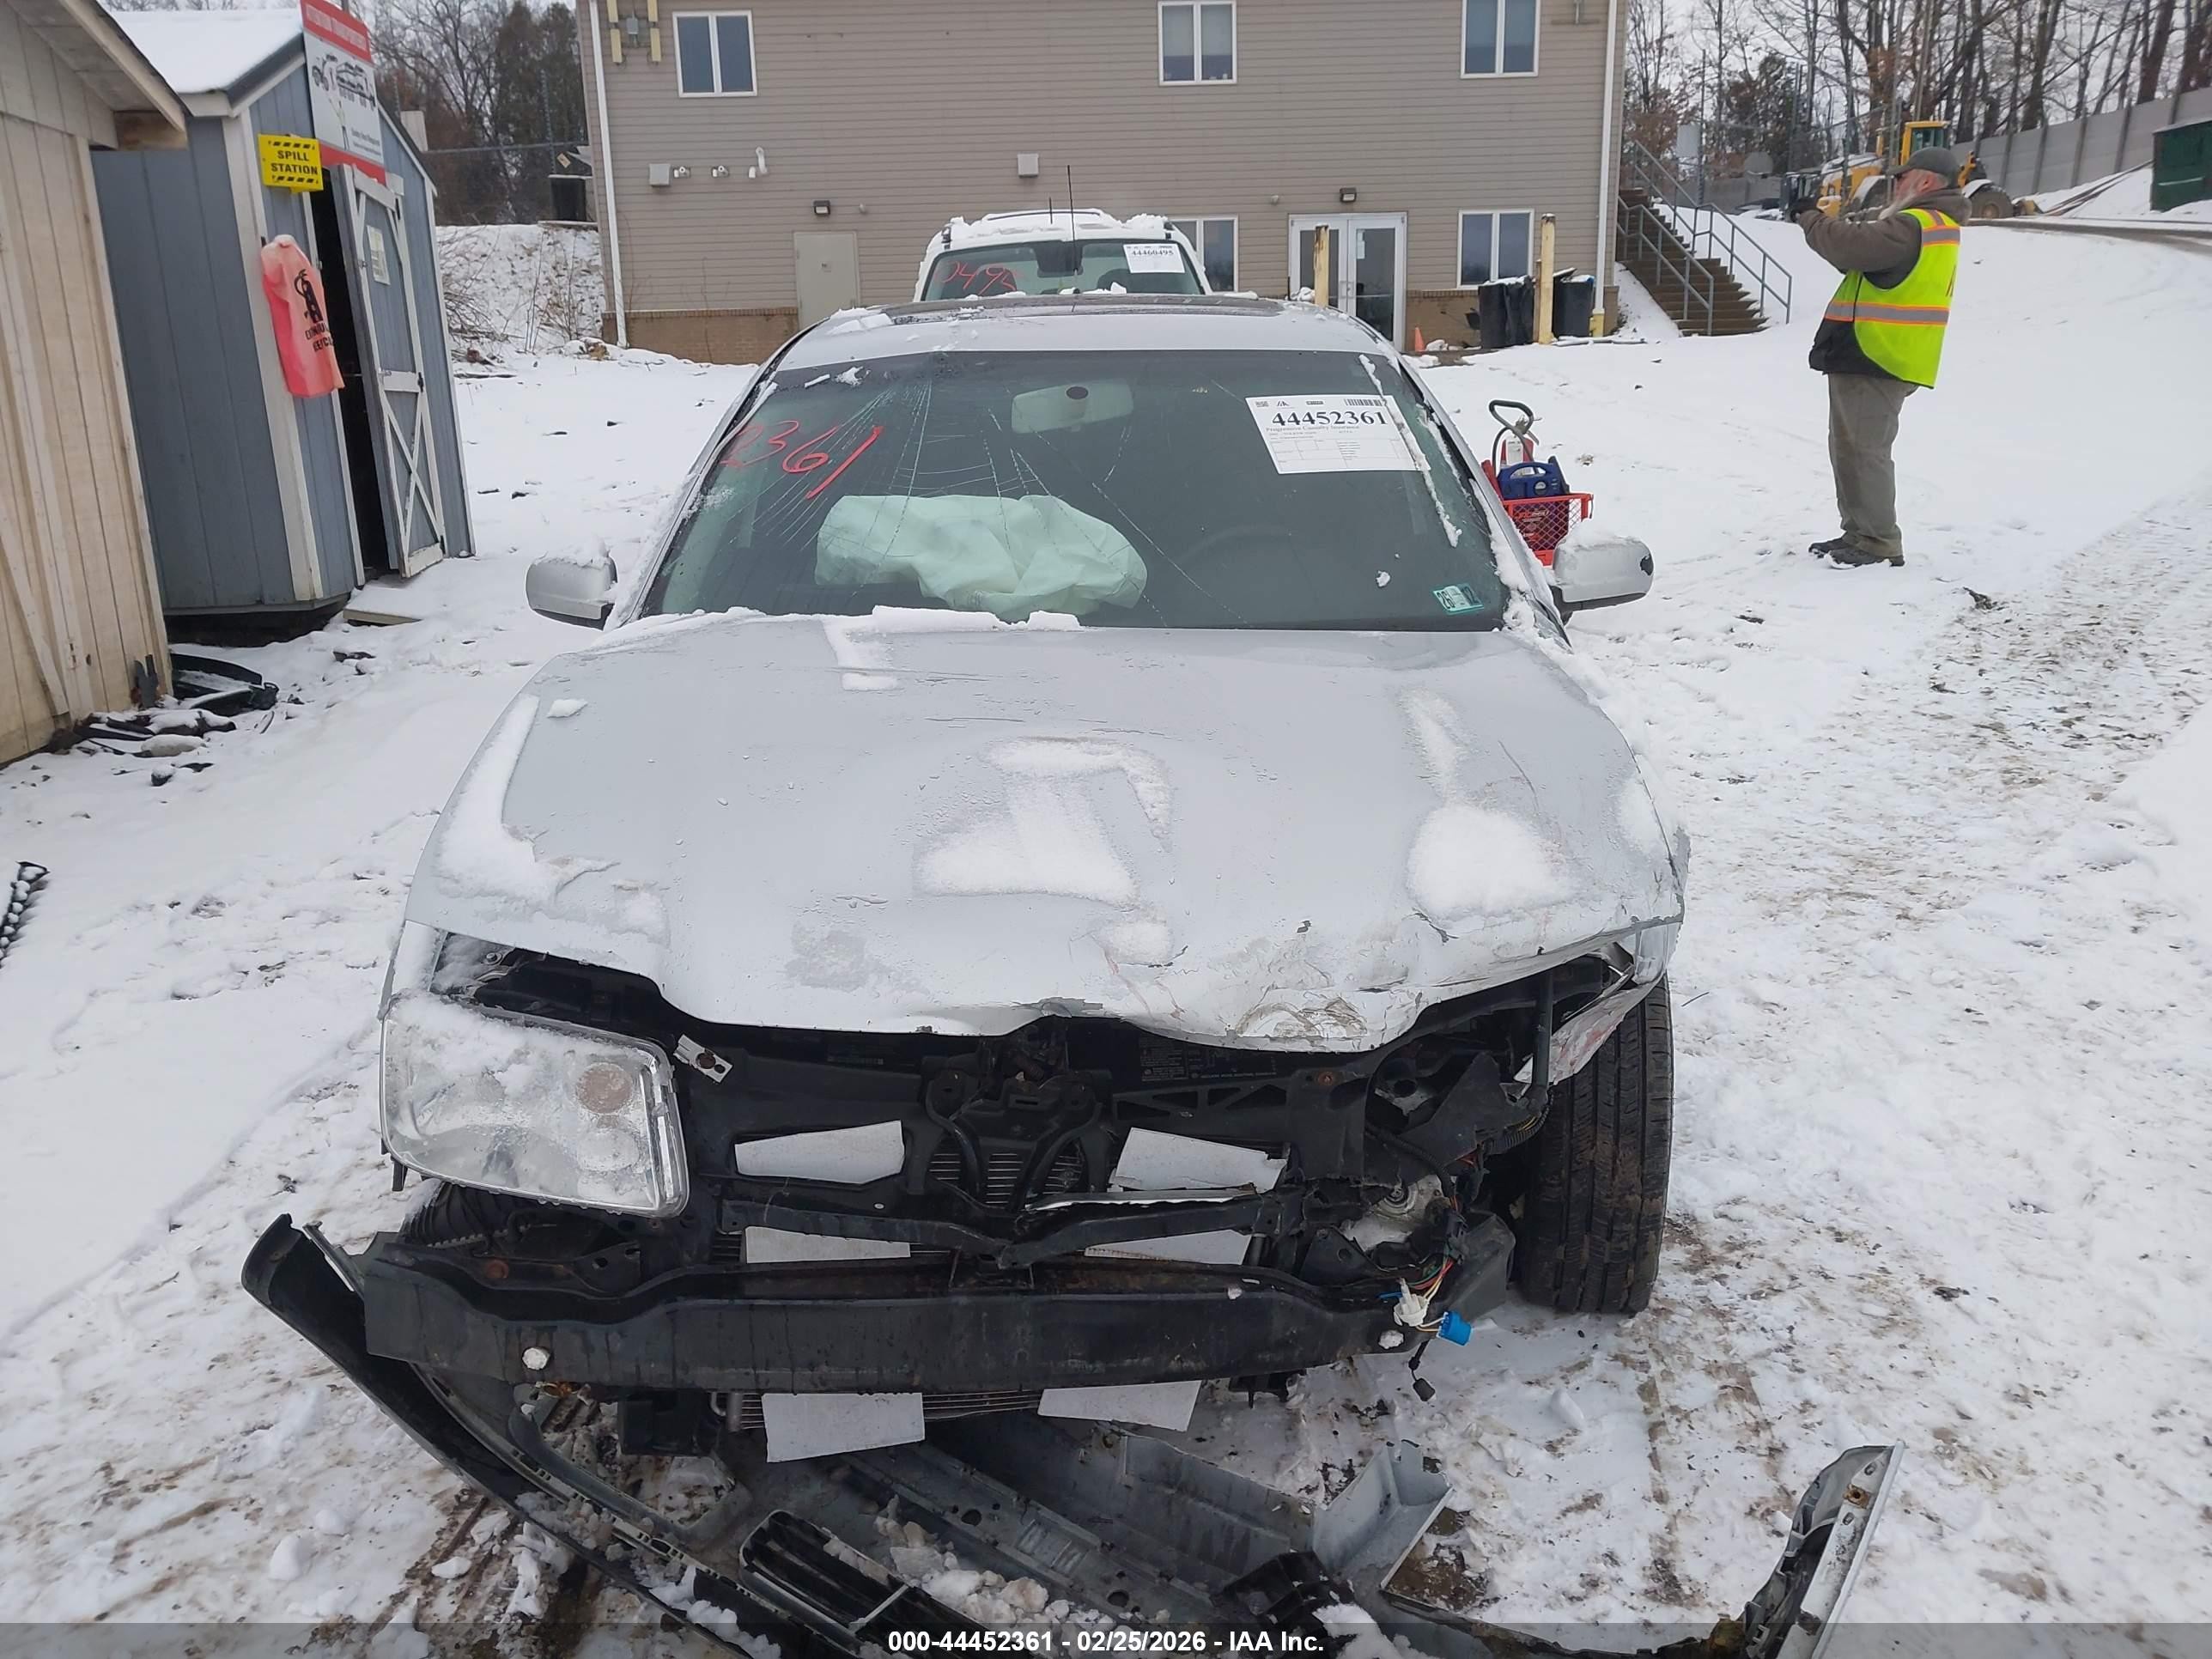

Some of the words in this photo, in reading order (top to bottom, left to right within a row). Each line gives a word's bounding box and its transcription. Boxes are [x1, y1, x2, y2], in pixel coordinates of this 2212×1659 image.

[276, 150, 310, 161] SPILL
[270, 162, 318, 175] STATION
[1272, 410, 1389, 427] 44452361
[719, 420, 884, 500] 2361
